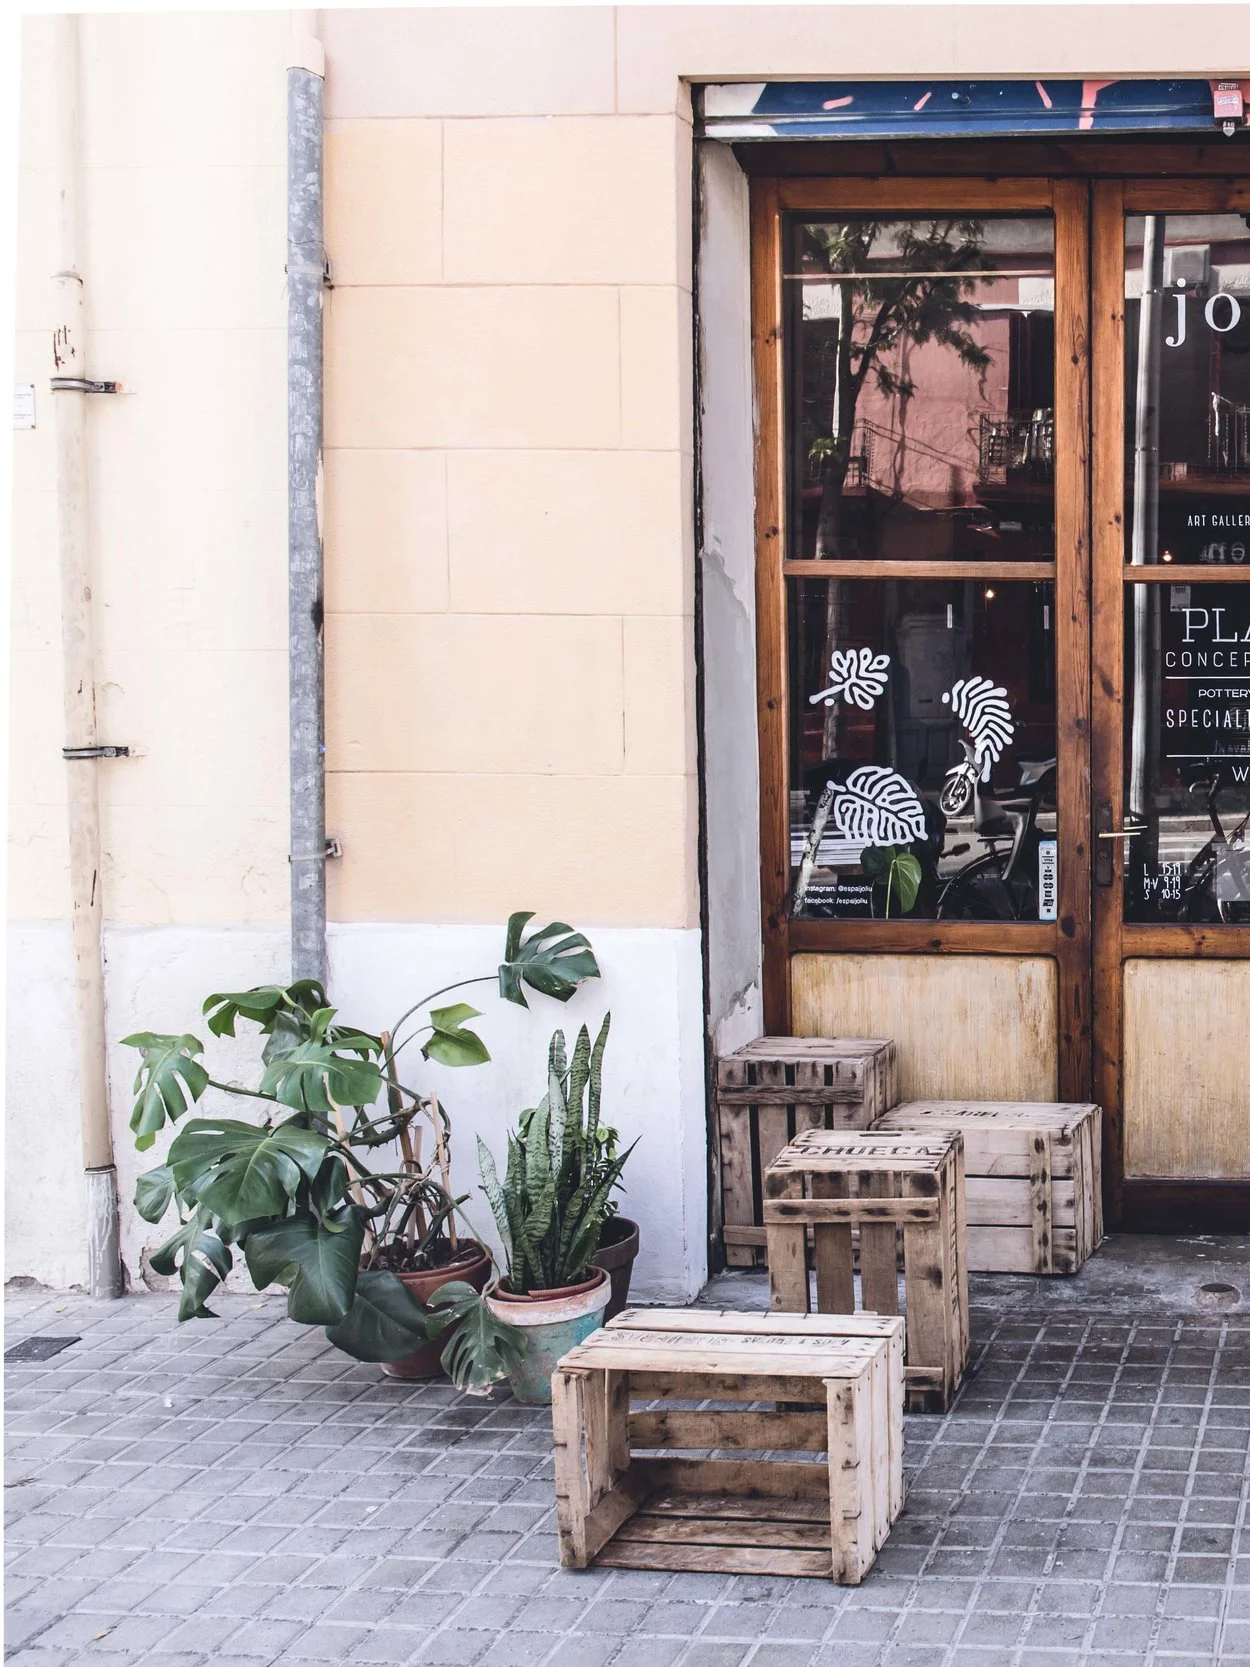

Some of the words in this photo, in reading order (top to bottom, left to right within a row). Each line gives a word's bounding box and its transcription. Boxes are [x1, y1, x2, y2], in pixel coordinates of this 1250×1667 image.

[1187, 514, 1206, 527] ART
[1143, 863, 1149, 876] L
[1162, 861, 1181, 876] 15-19
[1163, 876, 1181, 889] 9-19
[1143, 889, 1150, 900] S
[1161, 889, 1181, 900] 10-15
